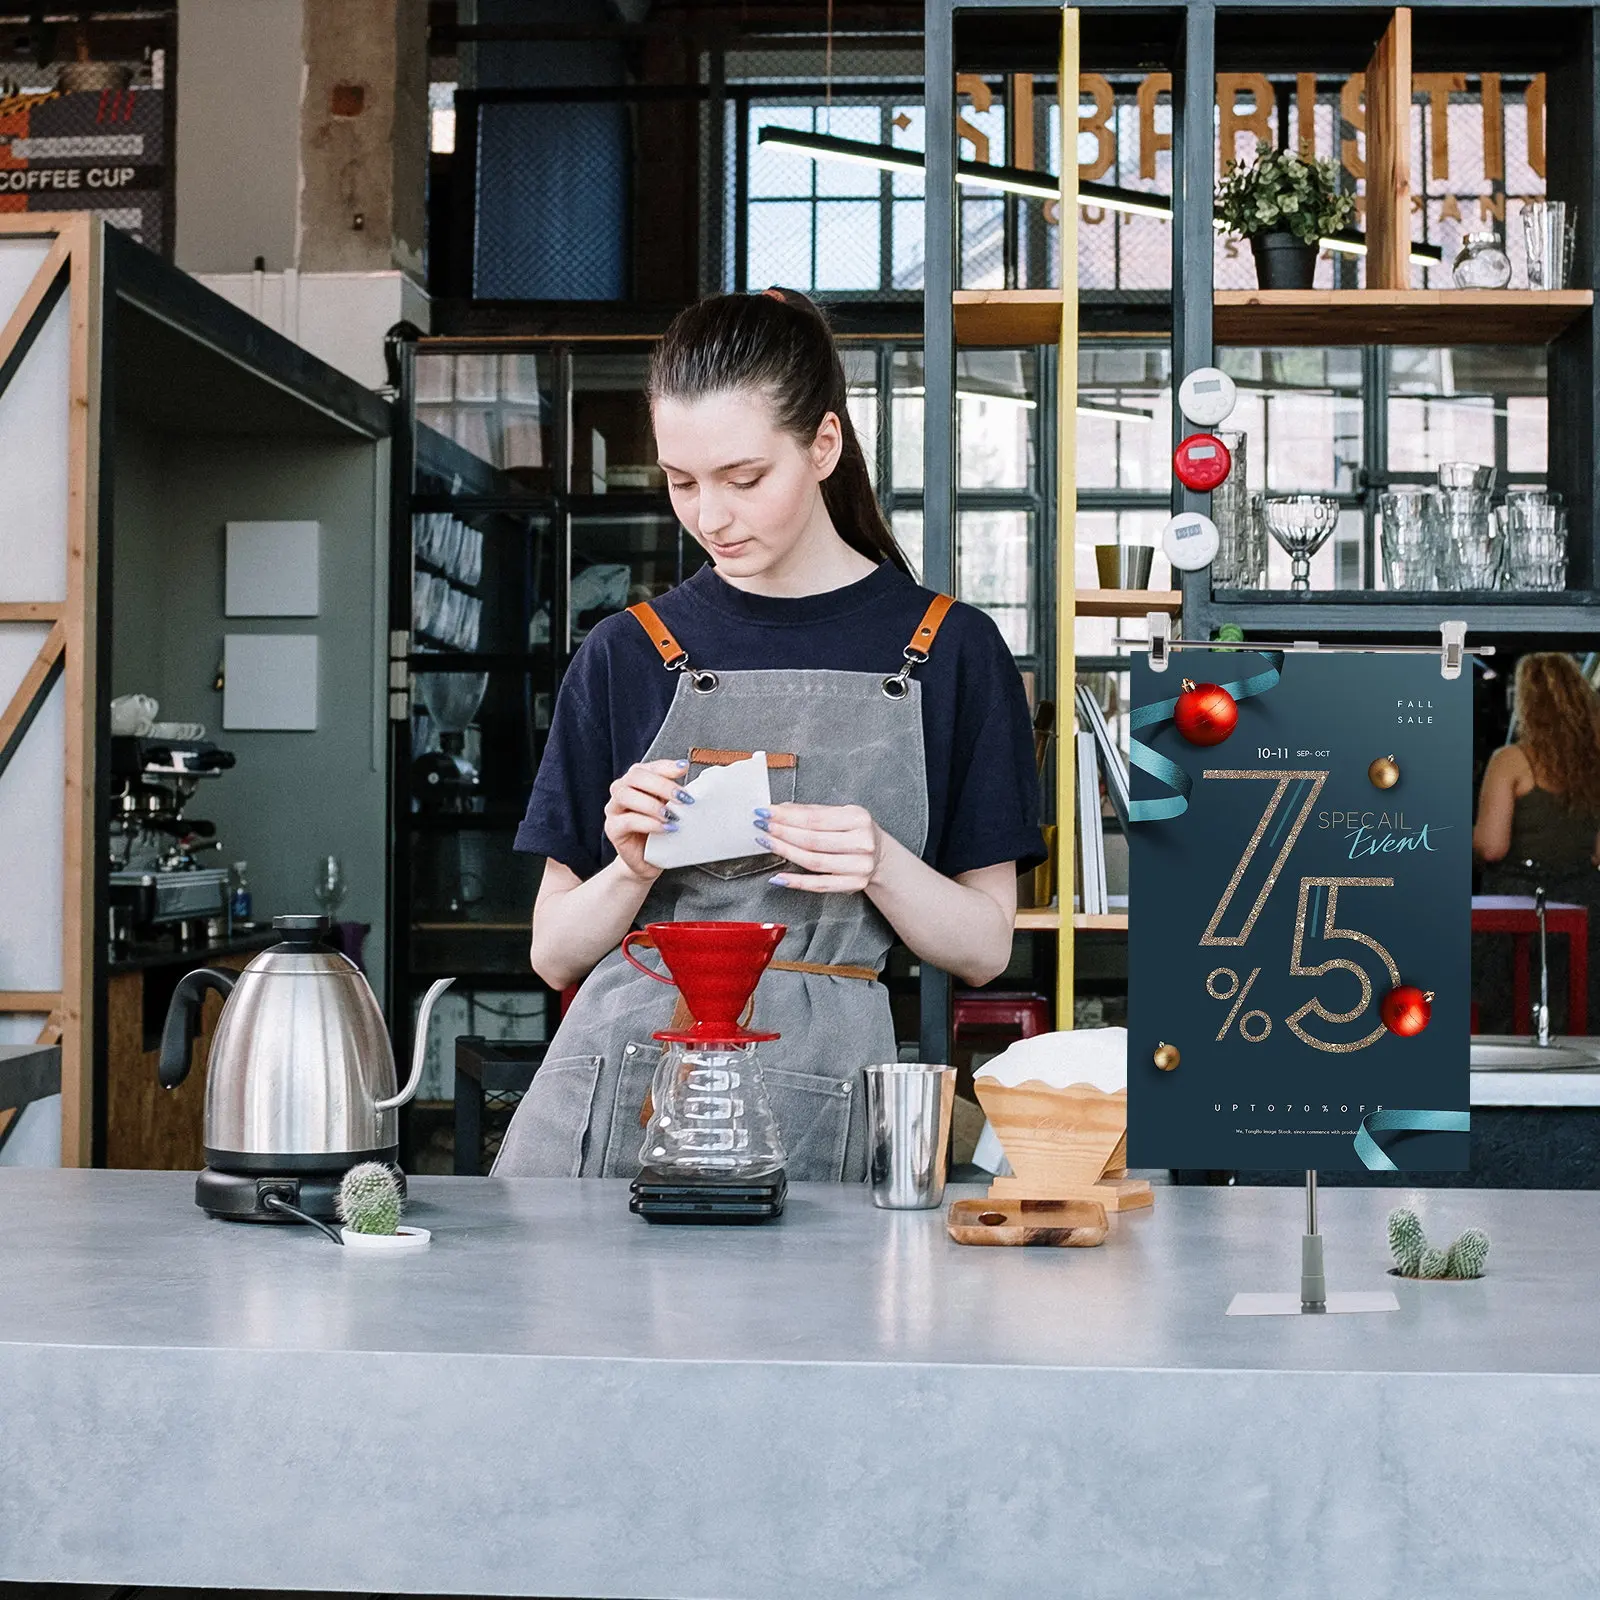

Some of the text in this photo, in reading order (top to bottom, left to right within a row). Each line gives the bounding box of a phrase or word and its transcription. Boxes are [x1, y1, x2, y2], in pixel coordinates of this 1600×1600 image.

[0, 168, 135, 191] COFFEE CUP
[1397, 700, 1433, 708] FALL
[1397, 716, 1433, 724] SALE
[1257, 747, 1288, 759] 10-11
[1315, 750, 1331, 758] OCT
[1318, 811, 1411, 829] SPECAIL
[1344, 824, 1454, 860] Event
